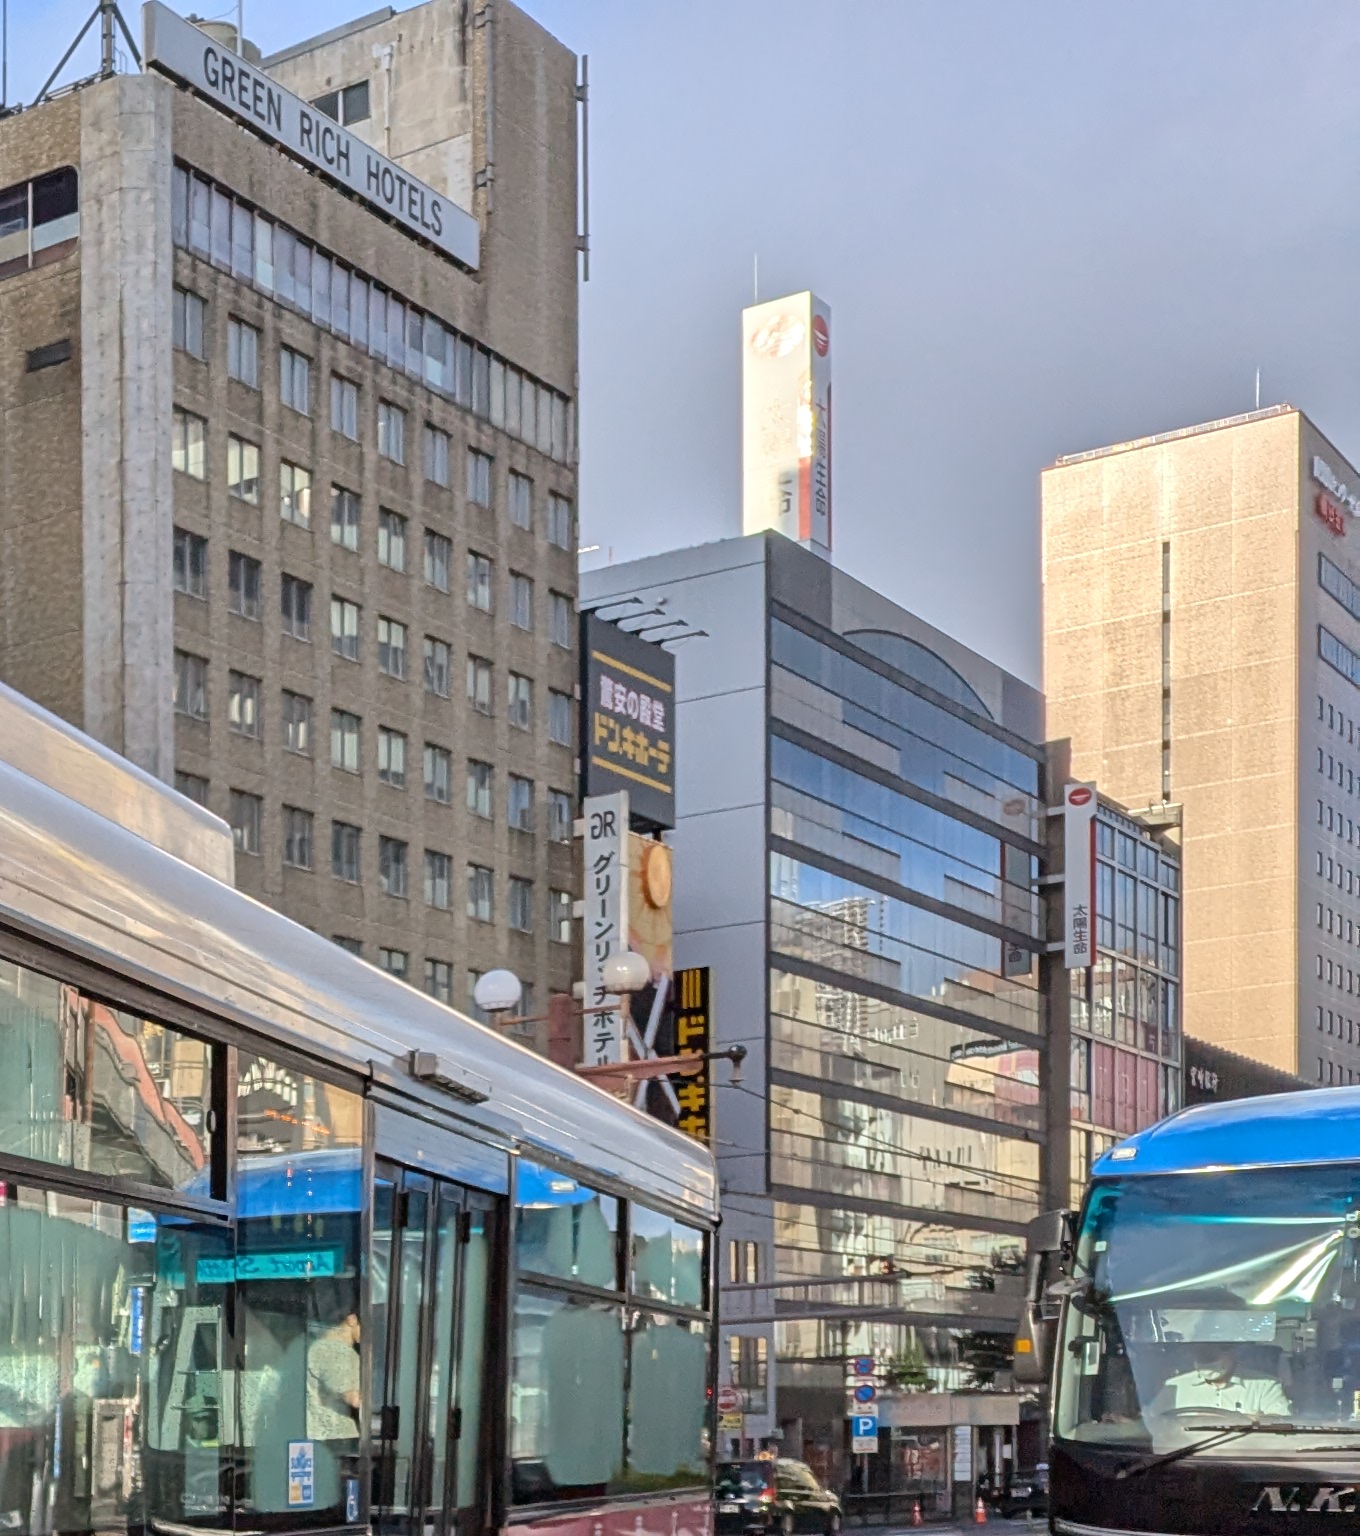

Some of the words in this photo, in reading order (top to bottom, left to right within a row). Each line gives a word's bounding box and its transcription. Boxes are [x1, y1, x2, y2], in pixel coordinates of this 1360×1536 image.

[203, 46, 282, 132] GREEN
[299, 109, 350, 177] RICH
[366, 154, 443, 237] HOTELS
